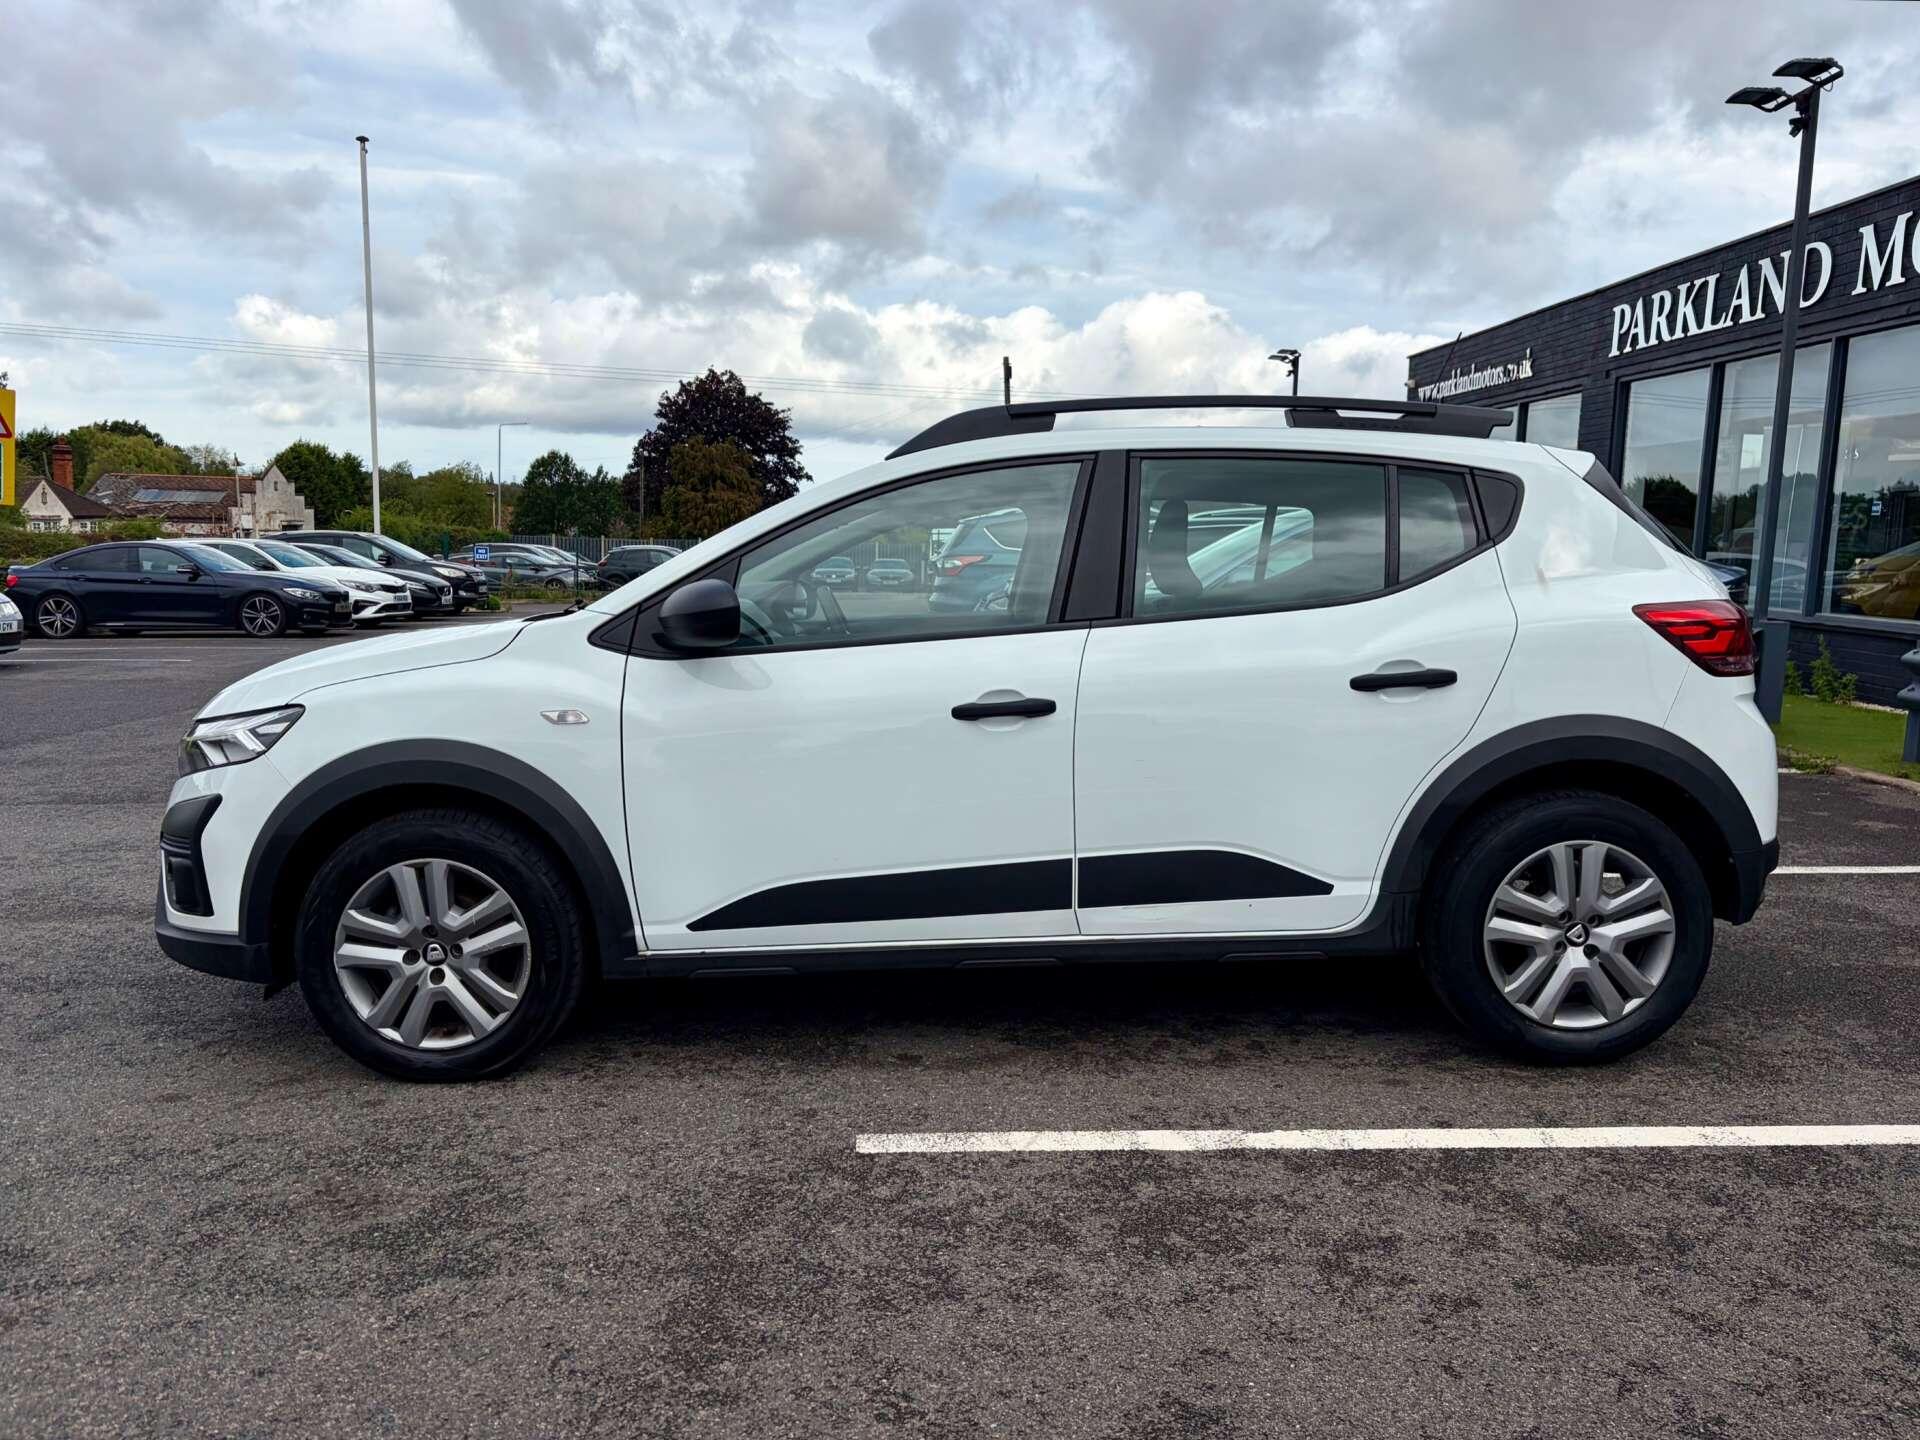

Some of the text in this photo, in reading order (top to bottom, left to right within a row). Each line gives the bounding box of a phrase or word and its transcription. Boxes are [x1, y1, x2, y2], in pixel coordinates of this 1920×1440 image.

[1608, 211, 1920, 358] PARKLAND M
[1418, 347, 1533, 402] www.parklandmotors.co.uk
